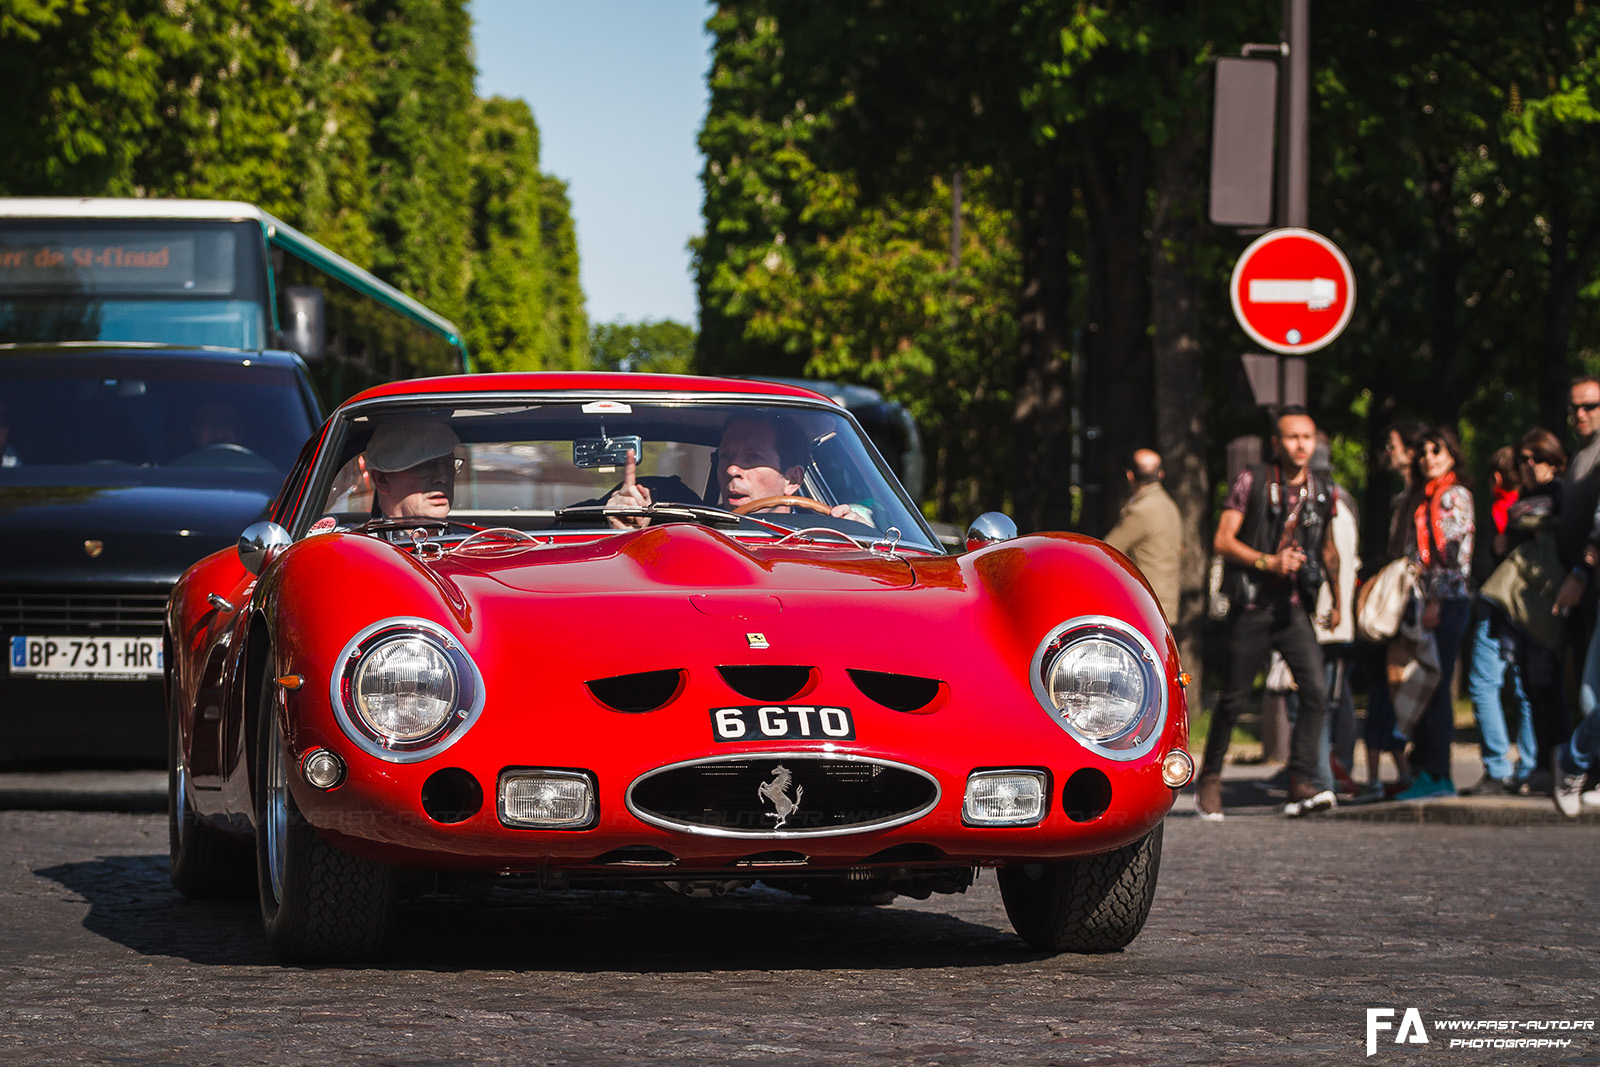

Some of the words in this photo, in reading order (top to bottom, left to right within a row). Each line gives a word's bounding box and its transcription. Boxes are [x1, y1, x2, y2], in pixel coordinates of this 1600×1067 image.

[30, 641, 153, 667] BP-731-HR
[715, 708, 746, 738] 6
[757, 706, 850, 737] GTO
